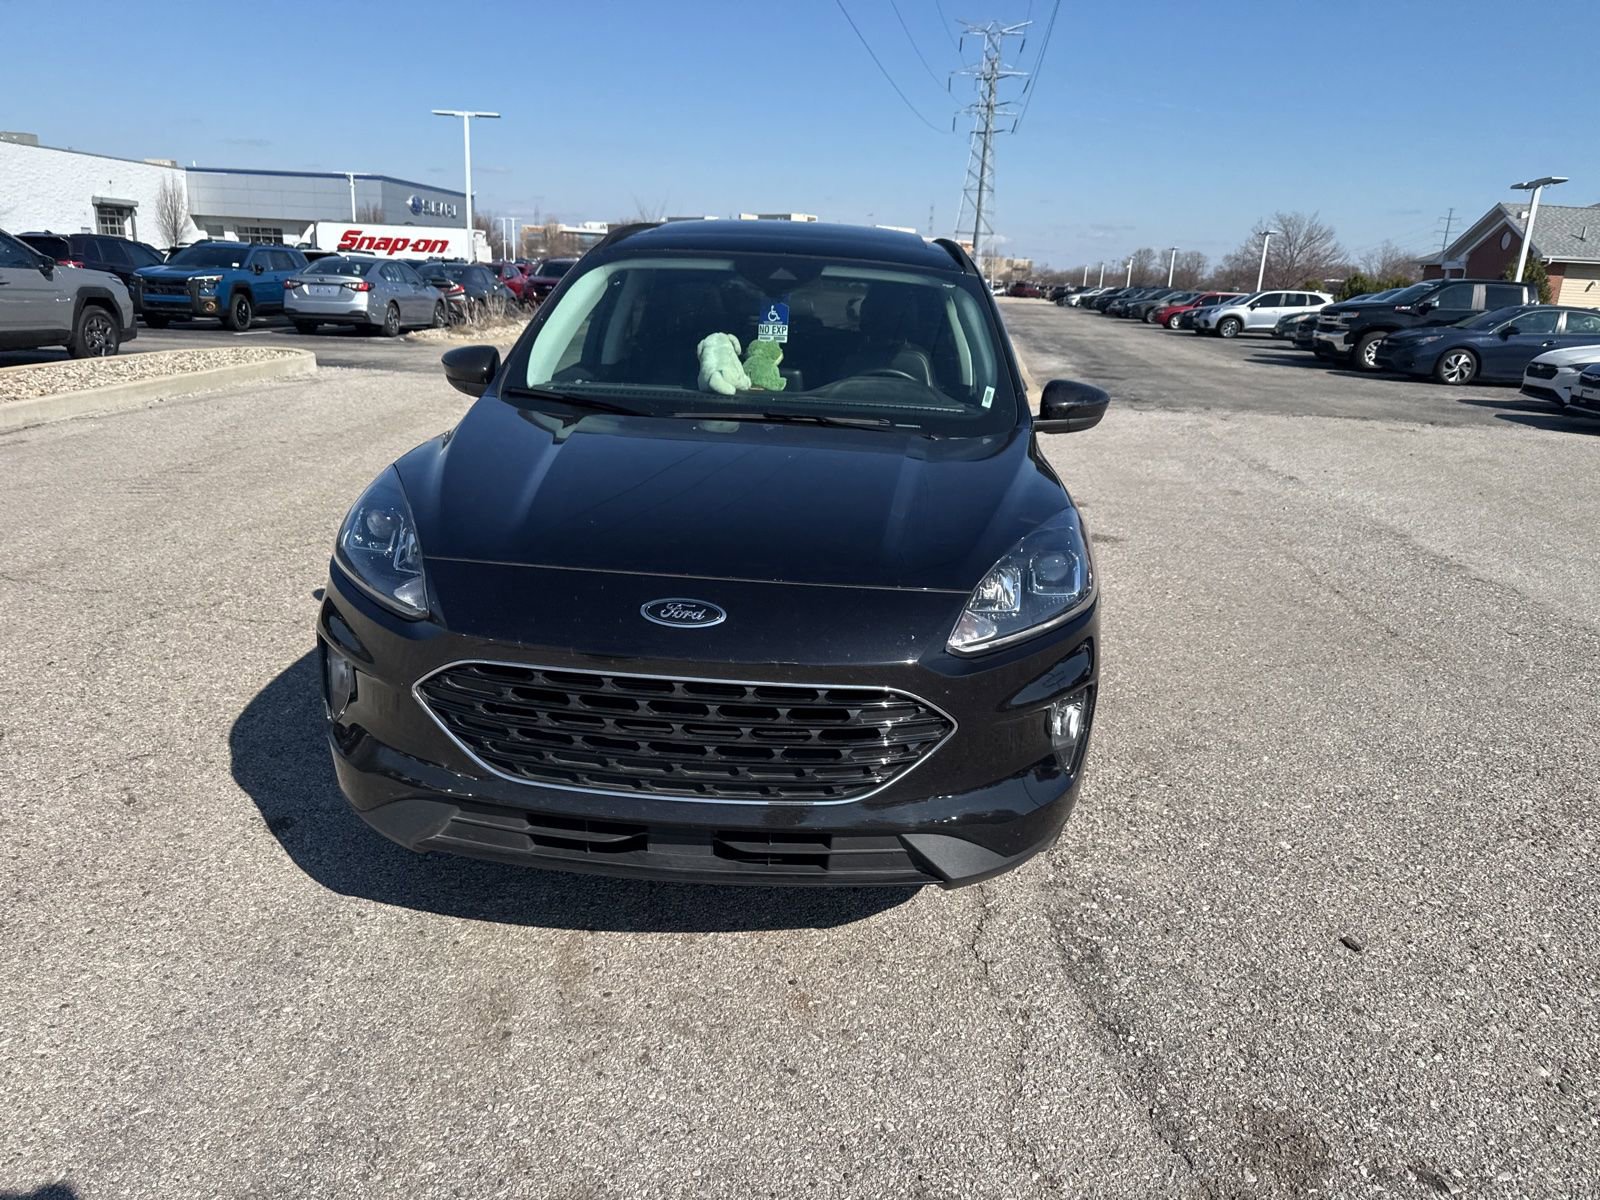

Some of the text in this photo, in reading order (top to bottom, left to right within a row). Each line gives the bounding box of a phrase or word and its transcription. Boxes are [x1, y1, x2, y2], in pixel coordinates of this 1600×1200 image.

[337, 230, 449, 255] Snap-on
[759, 325, 787, 335] NO EXP
[660, 602, 706, 620] Ford
